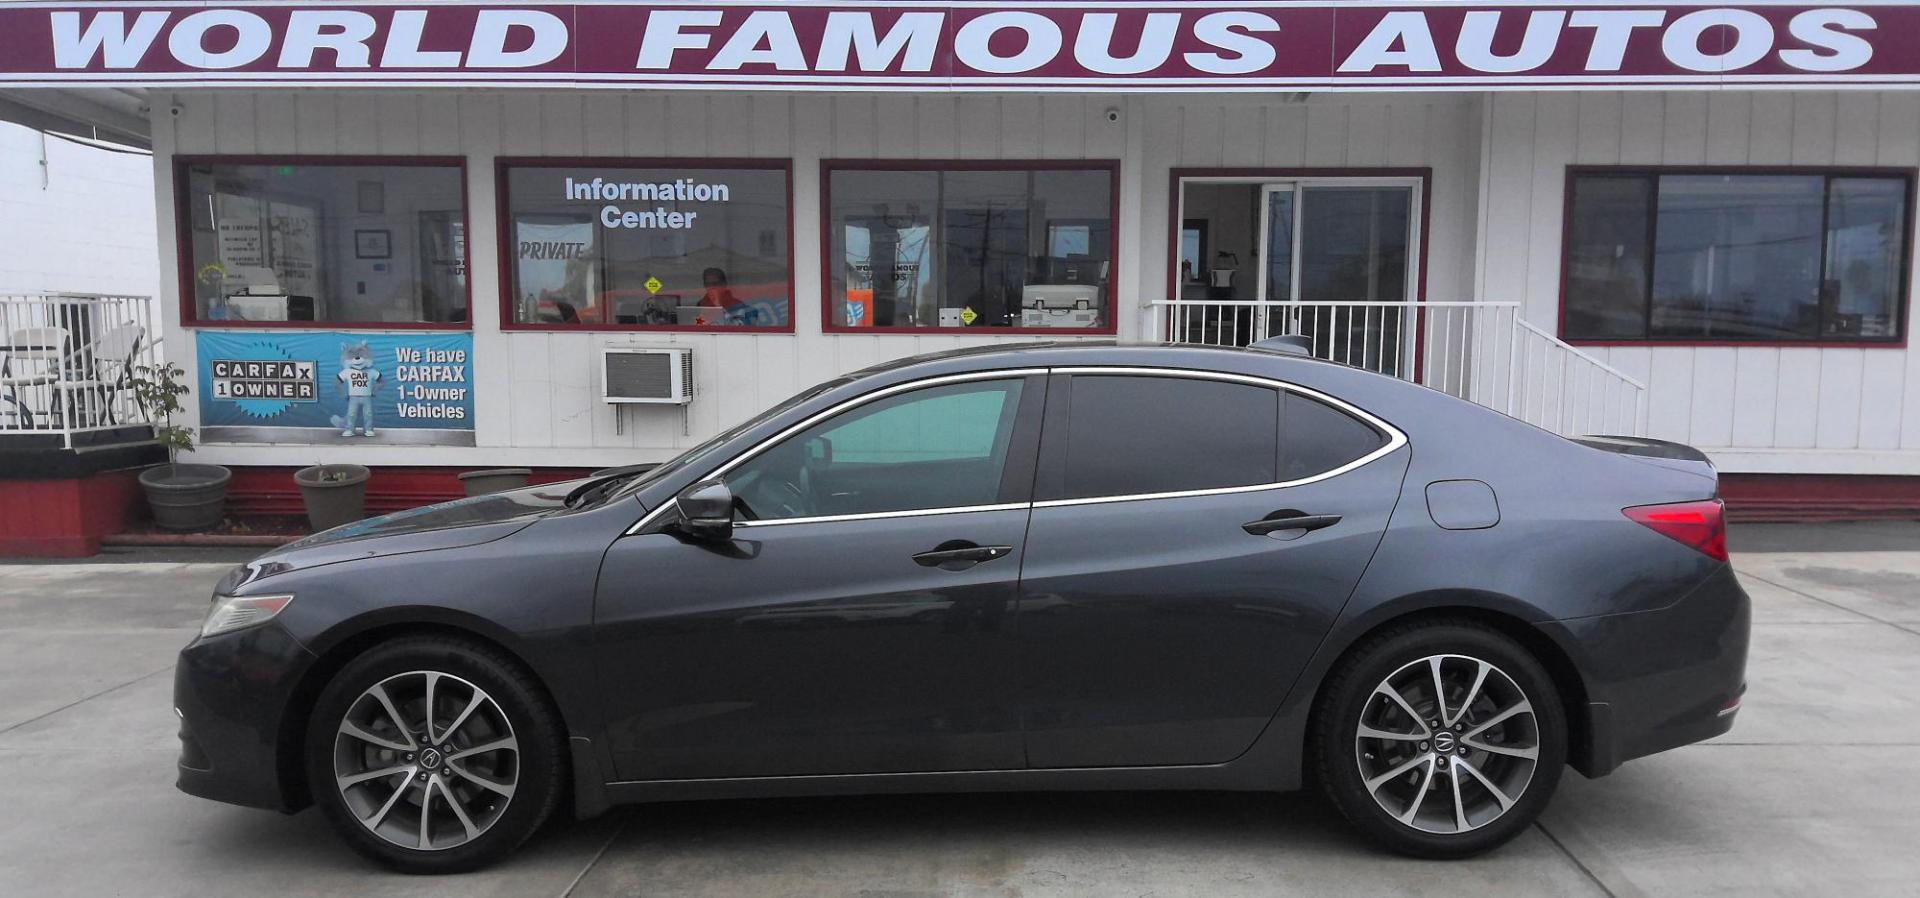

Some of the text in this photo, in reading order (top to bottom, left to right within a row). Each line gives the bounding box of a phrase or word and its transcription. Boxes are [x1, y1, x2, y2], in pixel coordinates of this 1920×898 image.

[50, 8, 1877, 74] WORLD FAMOUS AUTOS
[565, 177, 730, 202] Information
[600, 205, 697, 229] Center
[519, 240, 585, 260] PRIVATE
[395, 347, 465, 363] We have
[215, 362, 313, 380] CARFAX
[350, 372, 369, 381] CAR
[395, 366, 465, 382] CARFAX
[232, 382, 313, 398] OWNER
[351, 380, 369, 389] FOX
[397, 385, 466, 401] 1-Owner
[397, 403, 465, 419] Vehicles
